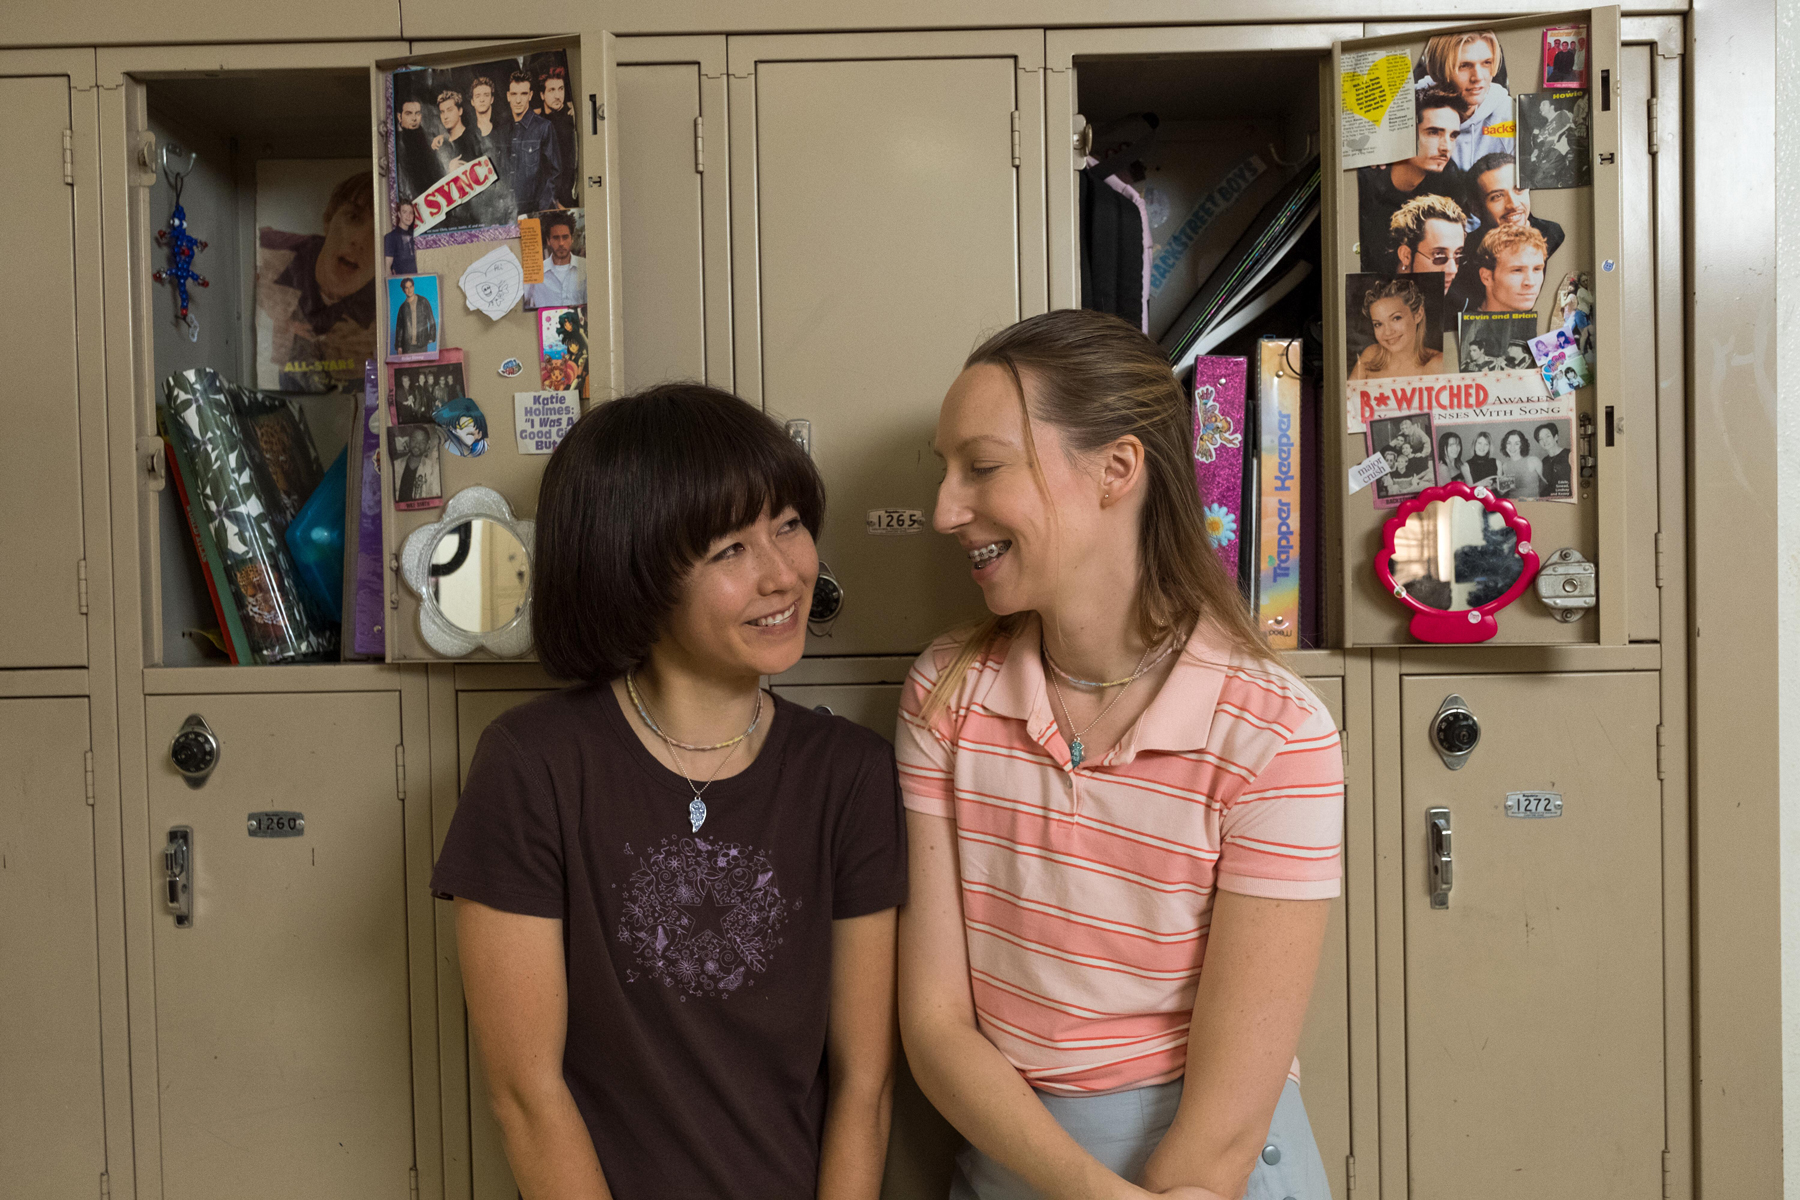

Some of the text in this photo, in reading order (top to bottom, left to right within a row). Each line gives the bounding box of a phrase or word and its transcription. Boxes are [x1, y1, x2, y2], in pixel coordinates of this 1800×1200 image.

[1552, 91, 1583, 100] Howie
[1150, 161, 1259, 288] BACKSTREET BOYS
[533, 393, 566, 406] Katie
[524, 405, 574, 417] Holmes:
[1432, 411, 1470, 420] ENSES
[539, 417, 562, 428] Was
[566, 416, 575, 427] A
[520, 427, 568, 440] Good Gi
[1358, 457, 1383, 476] major
[1362, 466, 1386, 484] crush
[1273, 410, 1295, 583] Trapper Keeper
[878, 514, 916, 528] 1265
[1517, 797, 1552, 812] 1272
[258, 816, 297, 830] 1260
